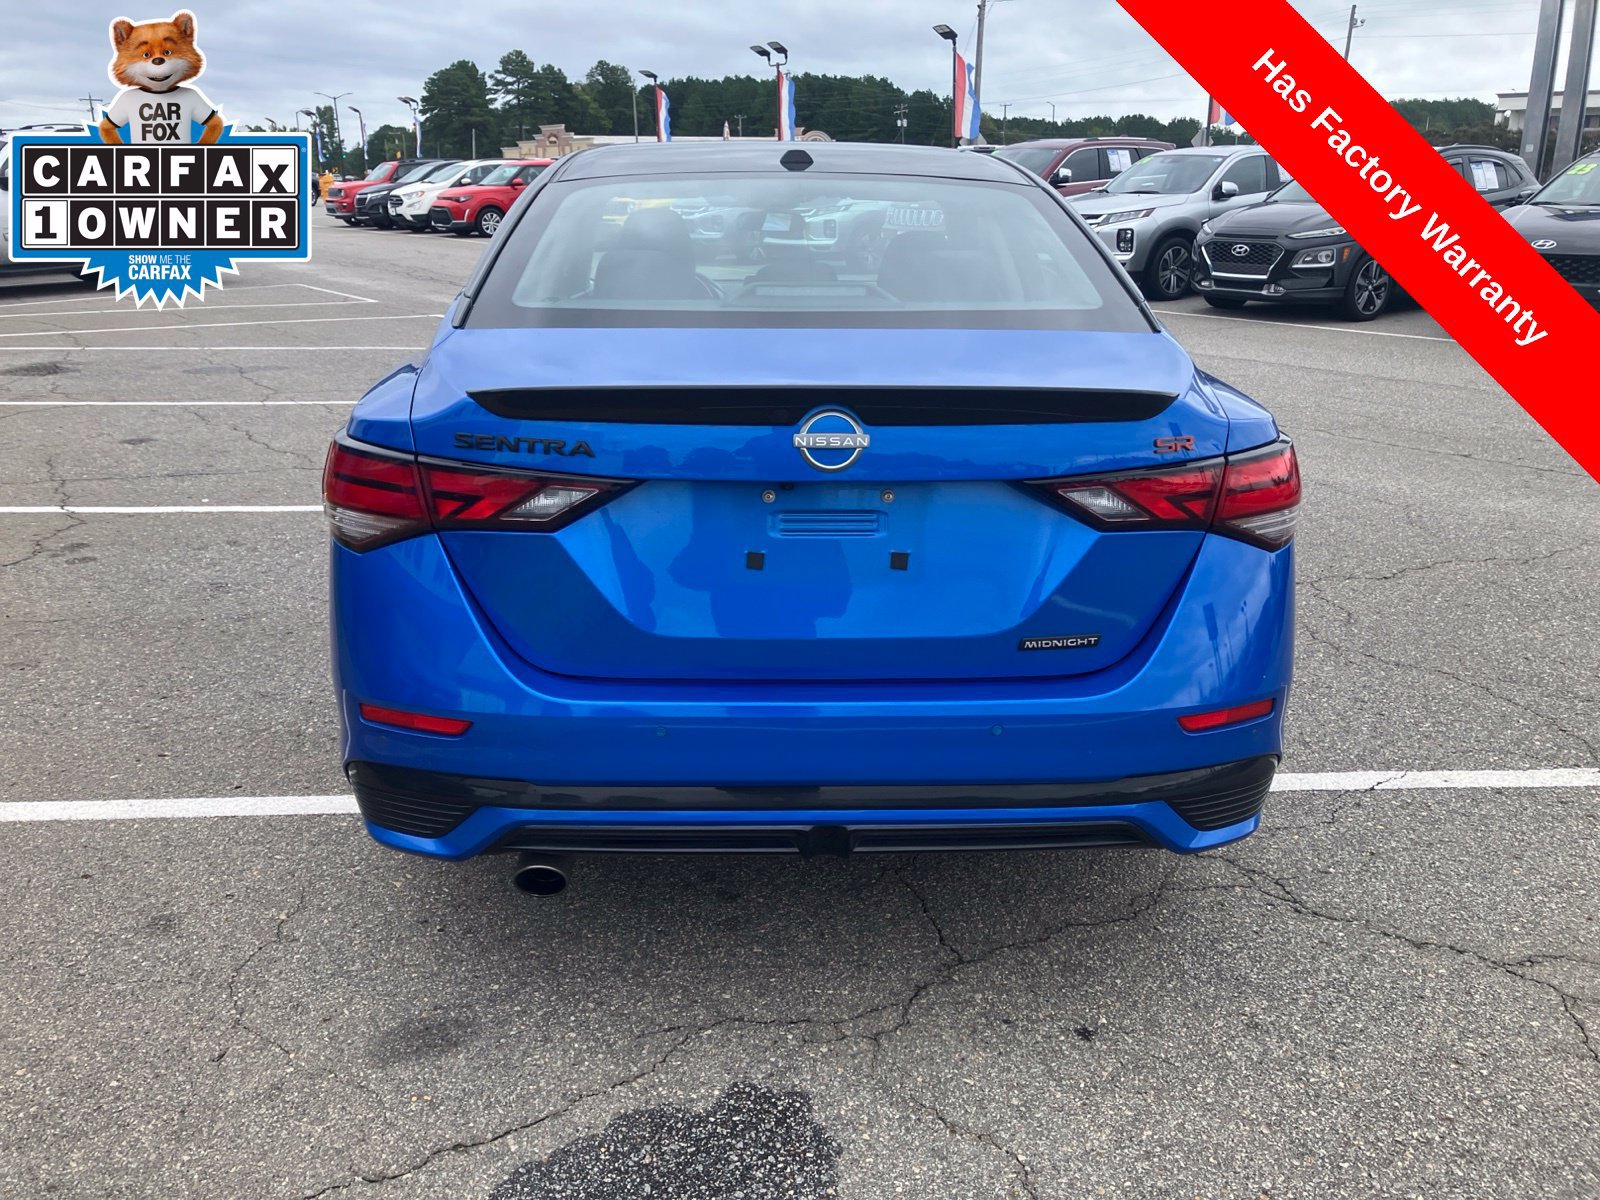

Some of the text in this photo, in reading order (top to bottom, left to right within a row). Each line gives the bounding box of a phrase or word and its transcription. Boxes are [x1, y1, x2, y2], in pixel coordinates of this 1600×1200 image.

[453, 431, 596, 458] SENTRA
[795, 434, 869, 447] NISSAN
[1153, 435, 1195, 453] SR
[1023, 636, 1099, 649] MIDNIGHT
